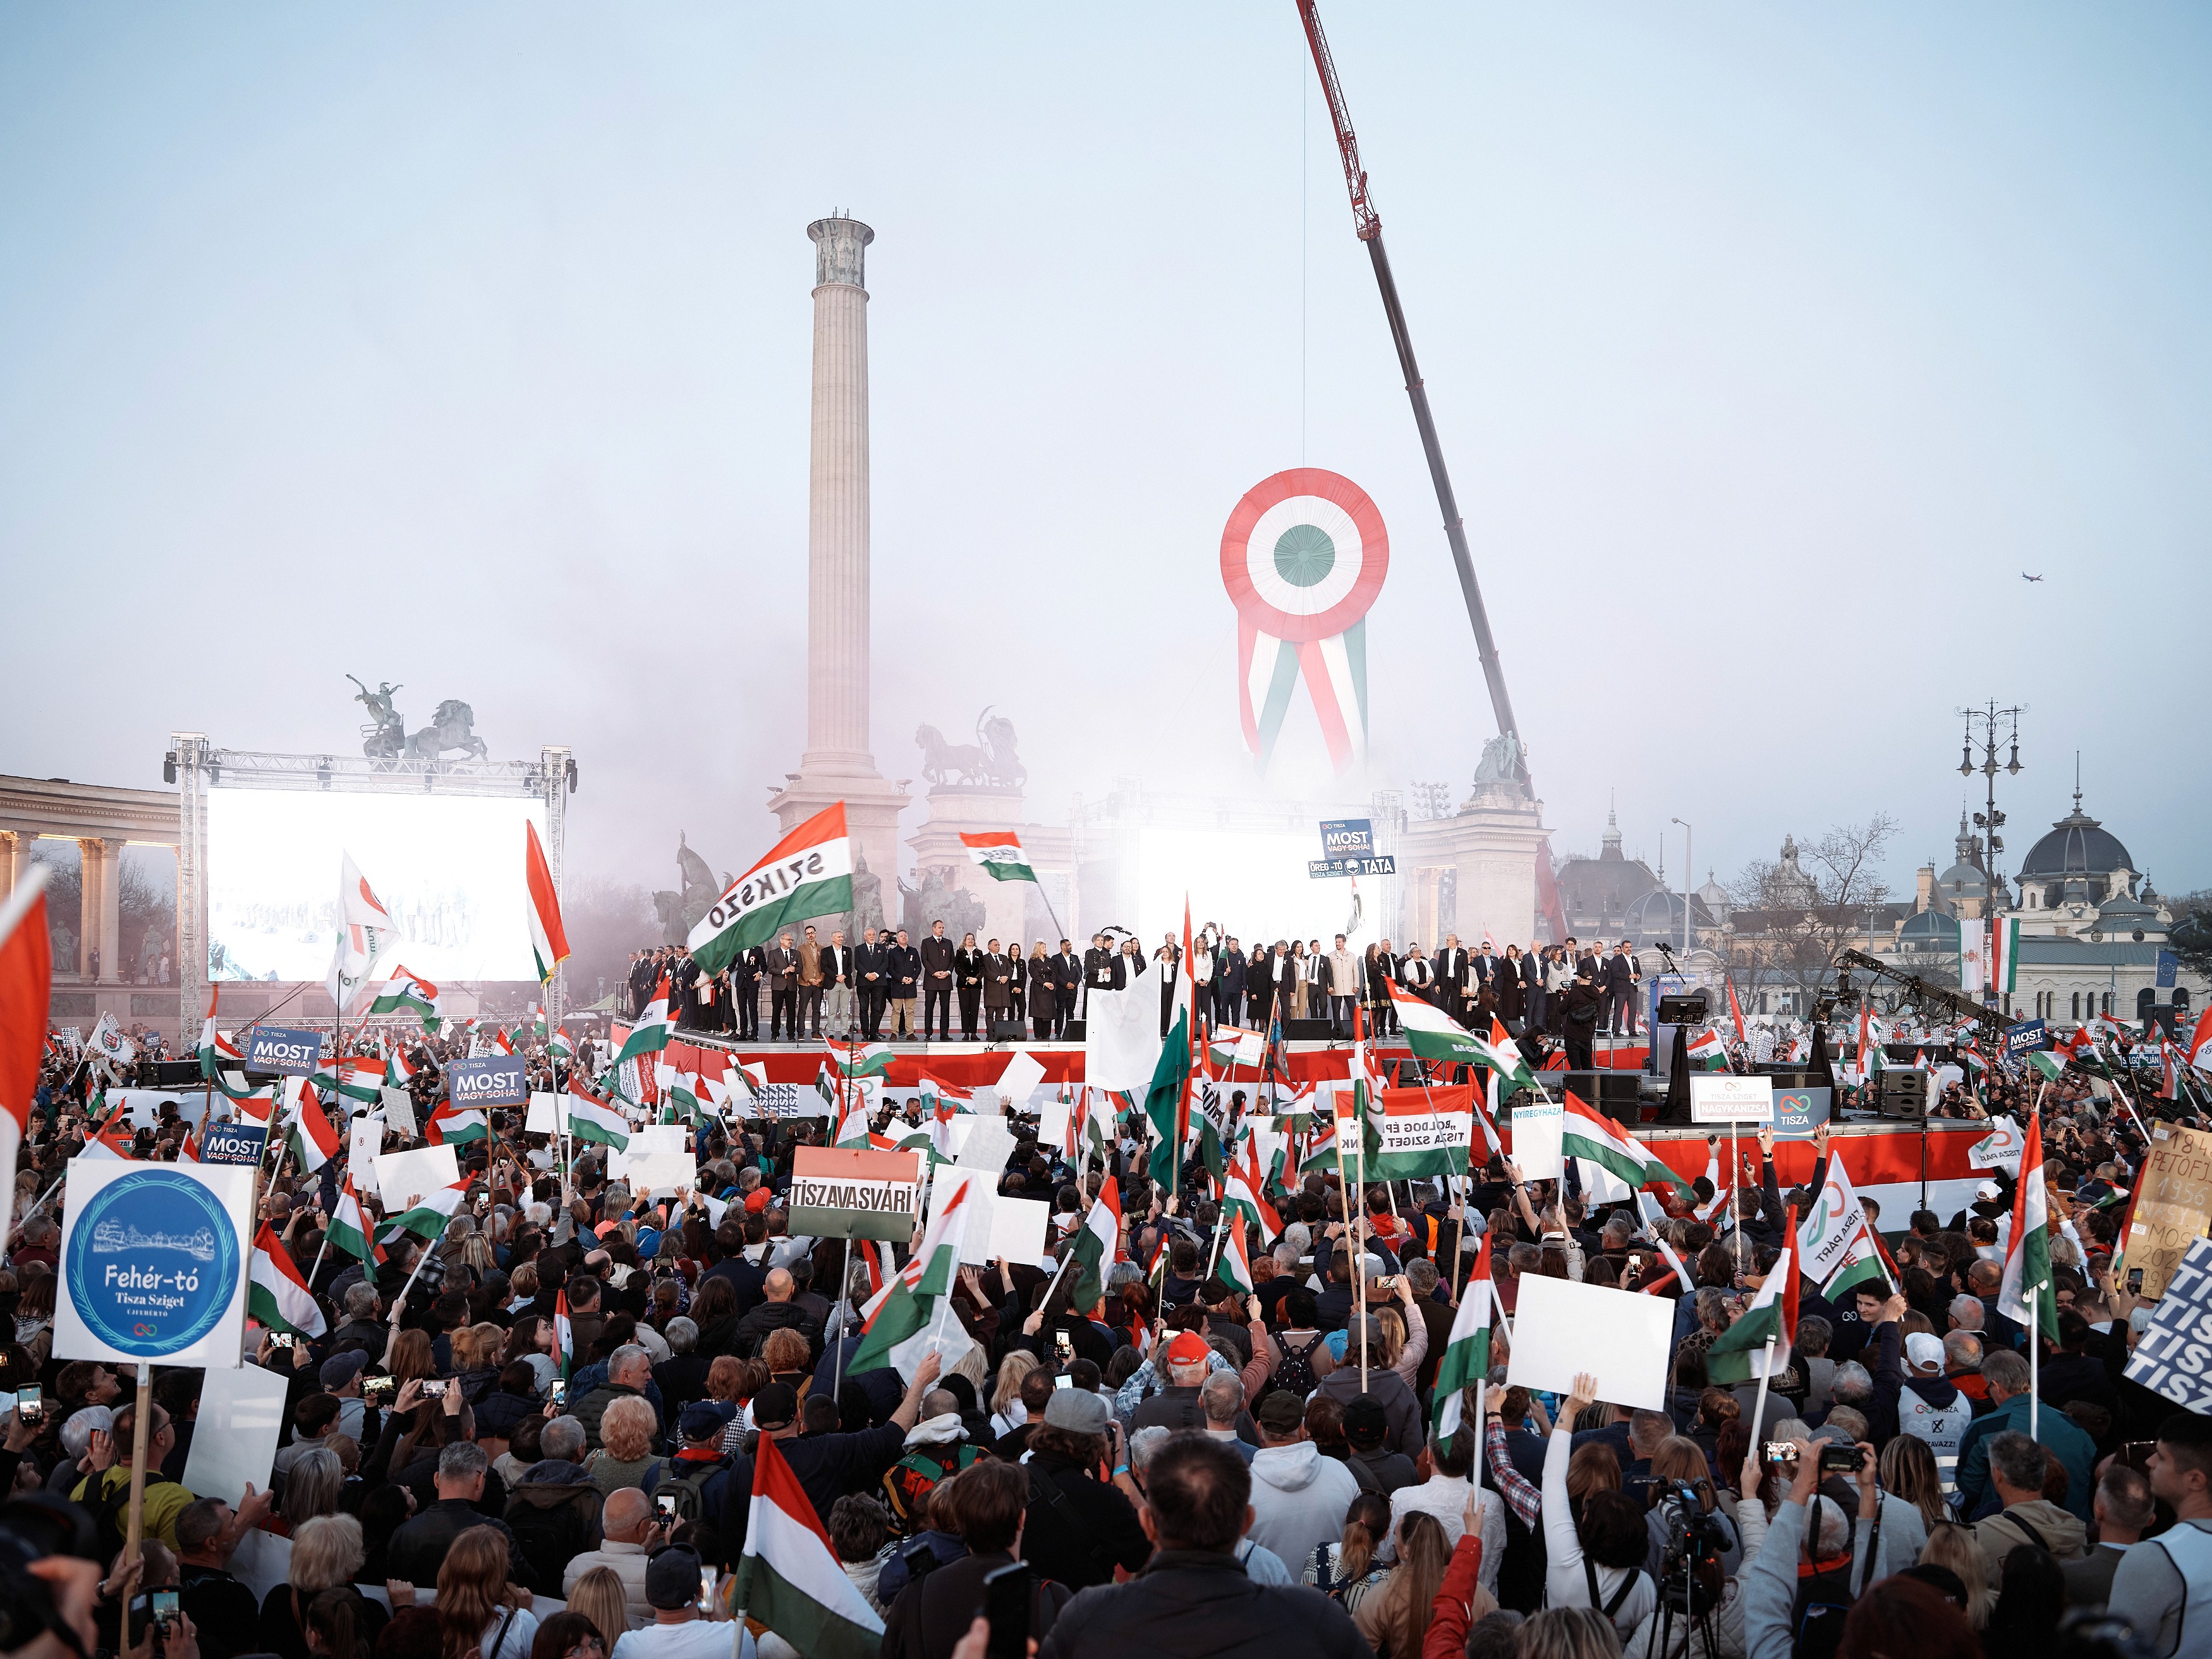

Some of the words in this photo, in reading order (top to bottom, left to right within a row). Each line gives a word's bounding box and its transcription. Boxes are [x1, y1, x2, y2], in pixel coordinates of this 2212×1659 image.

[1327, 831, 1368, 846] MOST
[1361, 858, 1394, 874] TATA
[2010, 1028, 2043, 1046] MOST
[2026, 1037, 2043, 1046] SOHA!
[254, 1041, 314, 1060] MOST
[253, 1055, 279, 1065] VAGY
[279, 1059, 310, 1069] SOHA!
[456, 1071, 519, 1092] MOST
[456, 1091, 484, 1101] VAGY
[486, 1088, 520, 1098] SOHA!
[779, 1084, 788, 1117] TISZA
[789, 1084, 798, 1117] TISZA
[1514, 1107, 1562, 1119] NYÍREGYHÁZA
[1701, 1104, 1768, 1114] NAGYKANIZSA
[1780, 1115, 1809, 1126] TISZA
[207, 1136, 262, 1155] MOST
[2170, 1131, 2212, 1158] 184
[206, 1151, 230, 1160] VAGY
[231, 1154, 258, 1164] SOHA!
[2158, 1177, 2208, 1206] 1956
[2148, 1223, 2191, 1251] MOS
[2139, 1245, 2176, 1272] 202
[105, 1264, 198, 1292] Fehér-tó
[116, 1292, 147, 1305] Tisza
[149, 1294, 185, 1310] Sziget
